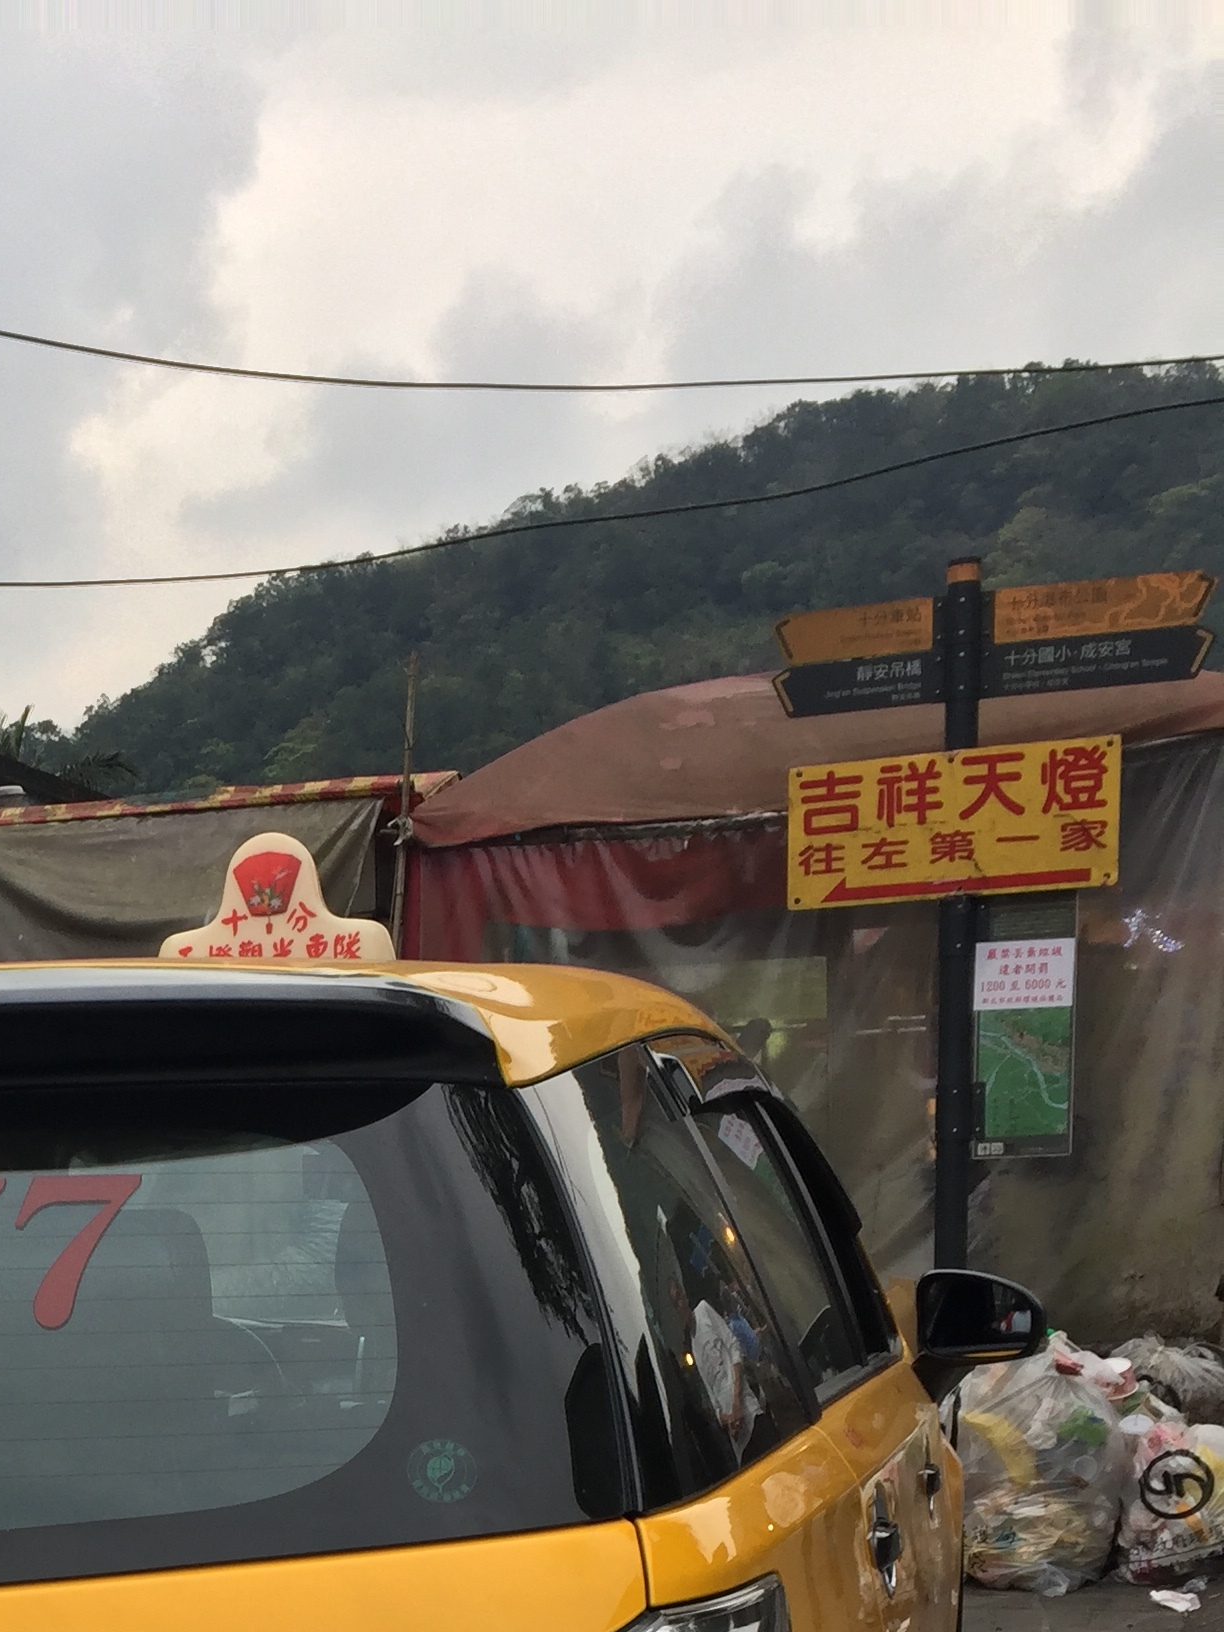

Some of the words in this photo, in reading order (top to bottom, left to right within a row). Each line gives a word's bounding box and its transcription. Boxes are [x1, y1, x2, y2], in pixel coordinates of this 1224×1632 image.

[798, 746, 1109, 836] 吉祥天燈
[797, 818, 1110, 876] 往左第一家
[980, 980, 1006, 993] 1200
[1025, 978, 1052, 991] 6000
